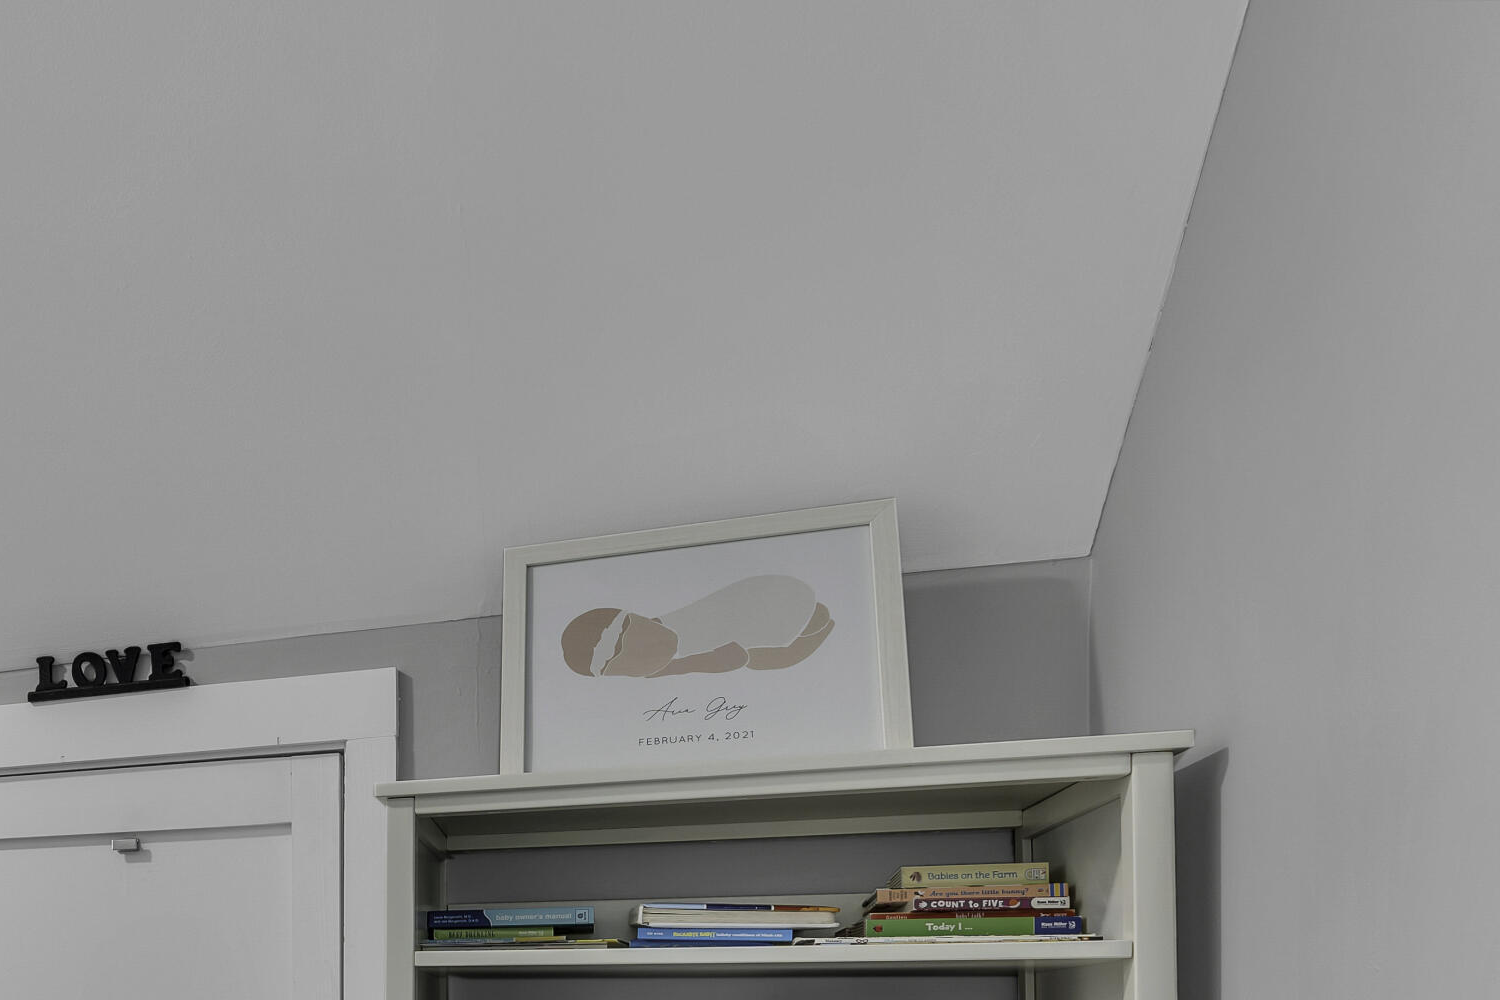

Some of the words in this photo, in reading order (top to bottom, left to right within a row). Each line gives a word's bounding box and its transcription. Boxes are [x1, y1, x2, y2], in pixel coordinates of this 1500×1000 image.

[35, 642, 182, 692] LOVE
[639, 734, 702, 746] FEBRUARY
[708, 733, 719, 741] 4,
[725, 730, 754, 740] 2021
[928, 872, 958, 880] Babies
[975, 871, 990, 879] the
[992, 870, 1018, 879] Farm
[931, 900, 965, 908] COUNT
[982, 899, 1004, 907] FIVE
[496, 914, 514, 923] baby
[925, 922, 956, 931] Today
